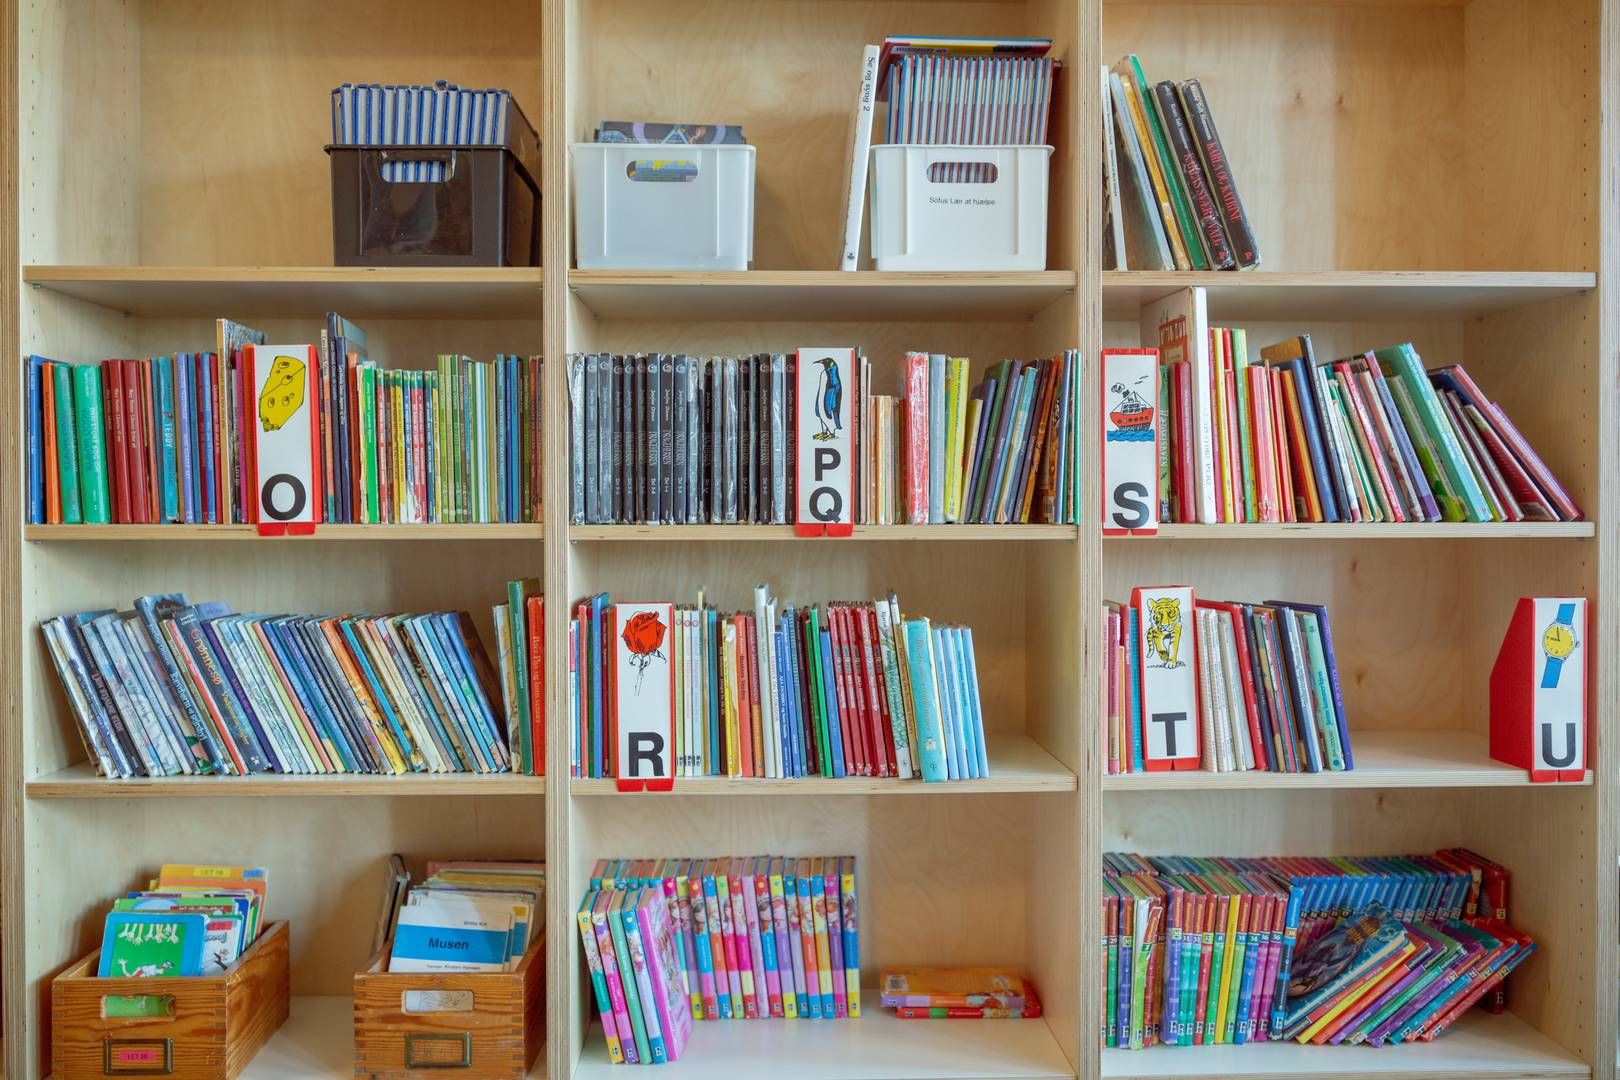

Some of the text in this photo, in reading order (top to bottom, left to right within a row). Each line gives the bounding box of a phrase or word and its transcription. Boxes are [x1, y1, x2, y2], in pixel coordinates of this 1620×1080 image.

[864, 69, 873, 81] og
[866, 56, 875, 68] Se
[862, 83, 872, 103] syng
[1205, 140, 1225, 170] KARLA
[929, 196, 948, 204] Sofus
[162, 422, 174, 448] TEDDY
[814, 448, 841, 482] P
[261, 473, 306, 520] O
[809, 486, 842, 524] Q
[1112, 482, 1150, 529] S
[1152, 712, 1187, 756] T
[1541, 722, 1576, 768] U
[628, 731, 665, 776] R
[427, 937, 470, 951] Musen
